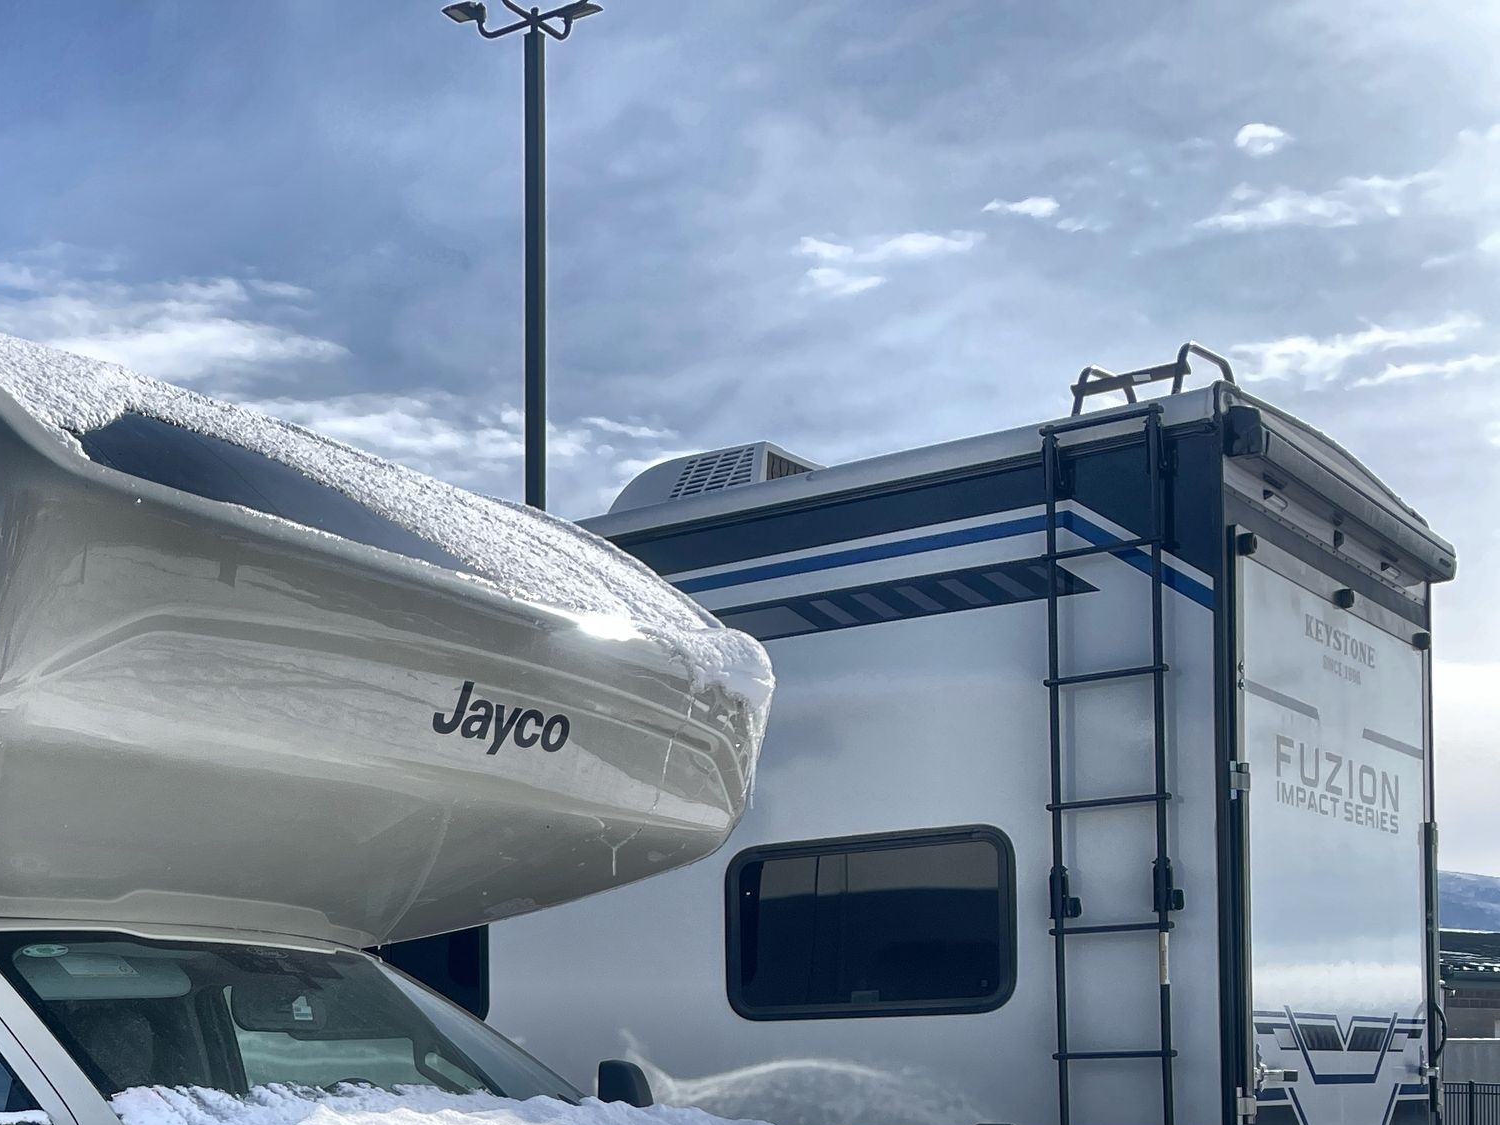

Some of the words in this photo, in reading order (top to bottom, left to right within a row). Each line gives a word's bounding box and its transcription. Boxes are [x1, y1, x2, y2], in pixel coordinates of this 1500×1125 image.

[1304, 613, 1376, 669] KEYSTONE
[432, 680, 570, 755] Jayco
[1276, 734, 1399, 812] FUZION
[1276, 780, 1340, 818] IMPACT
[1344, 801, 1399, 834] SERIES
